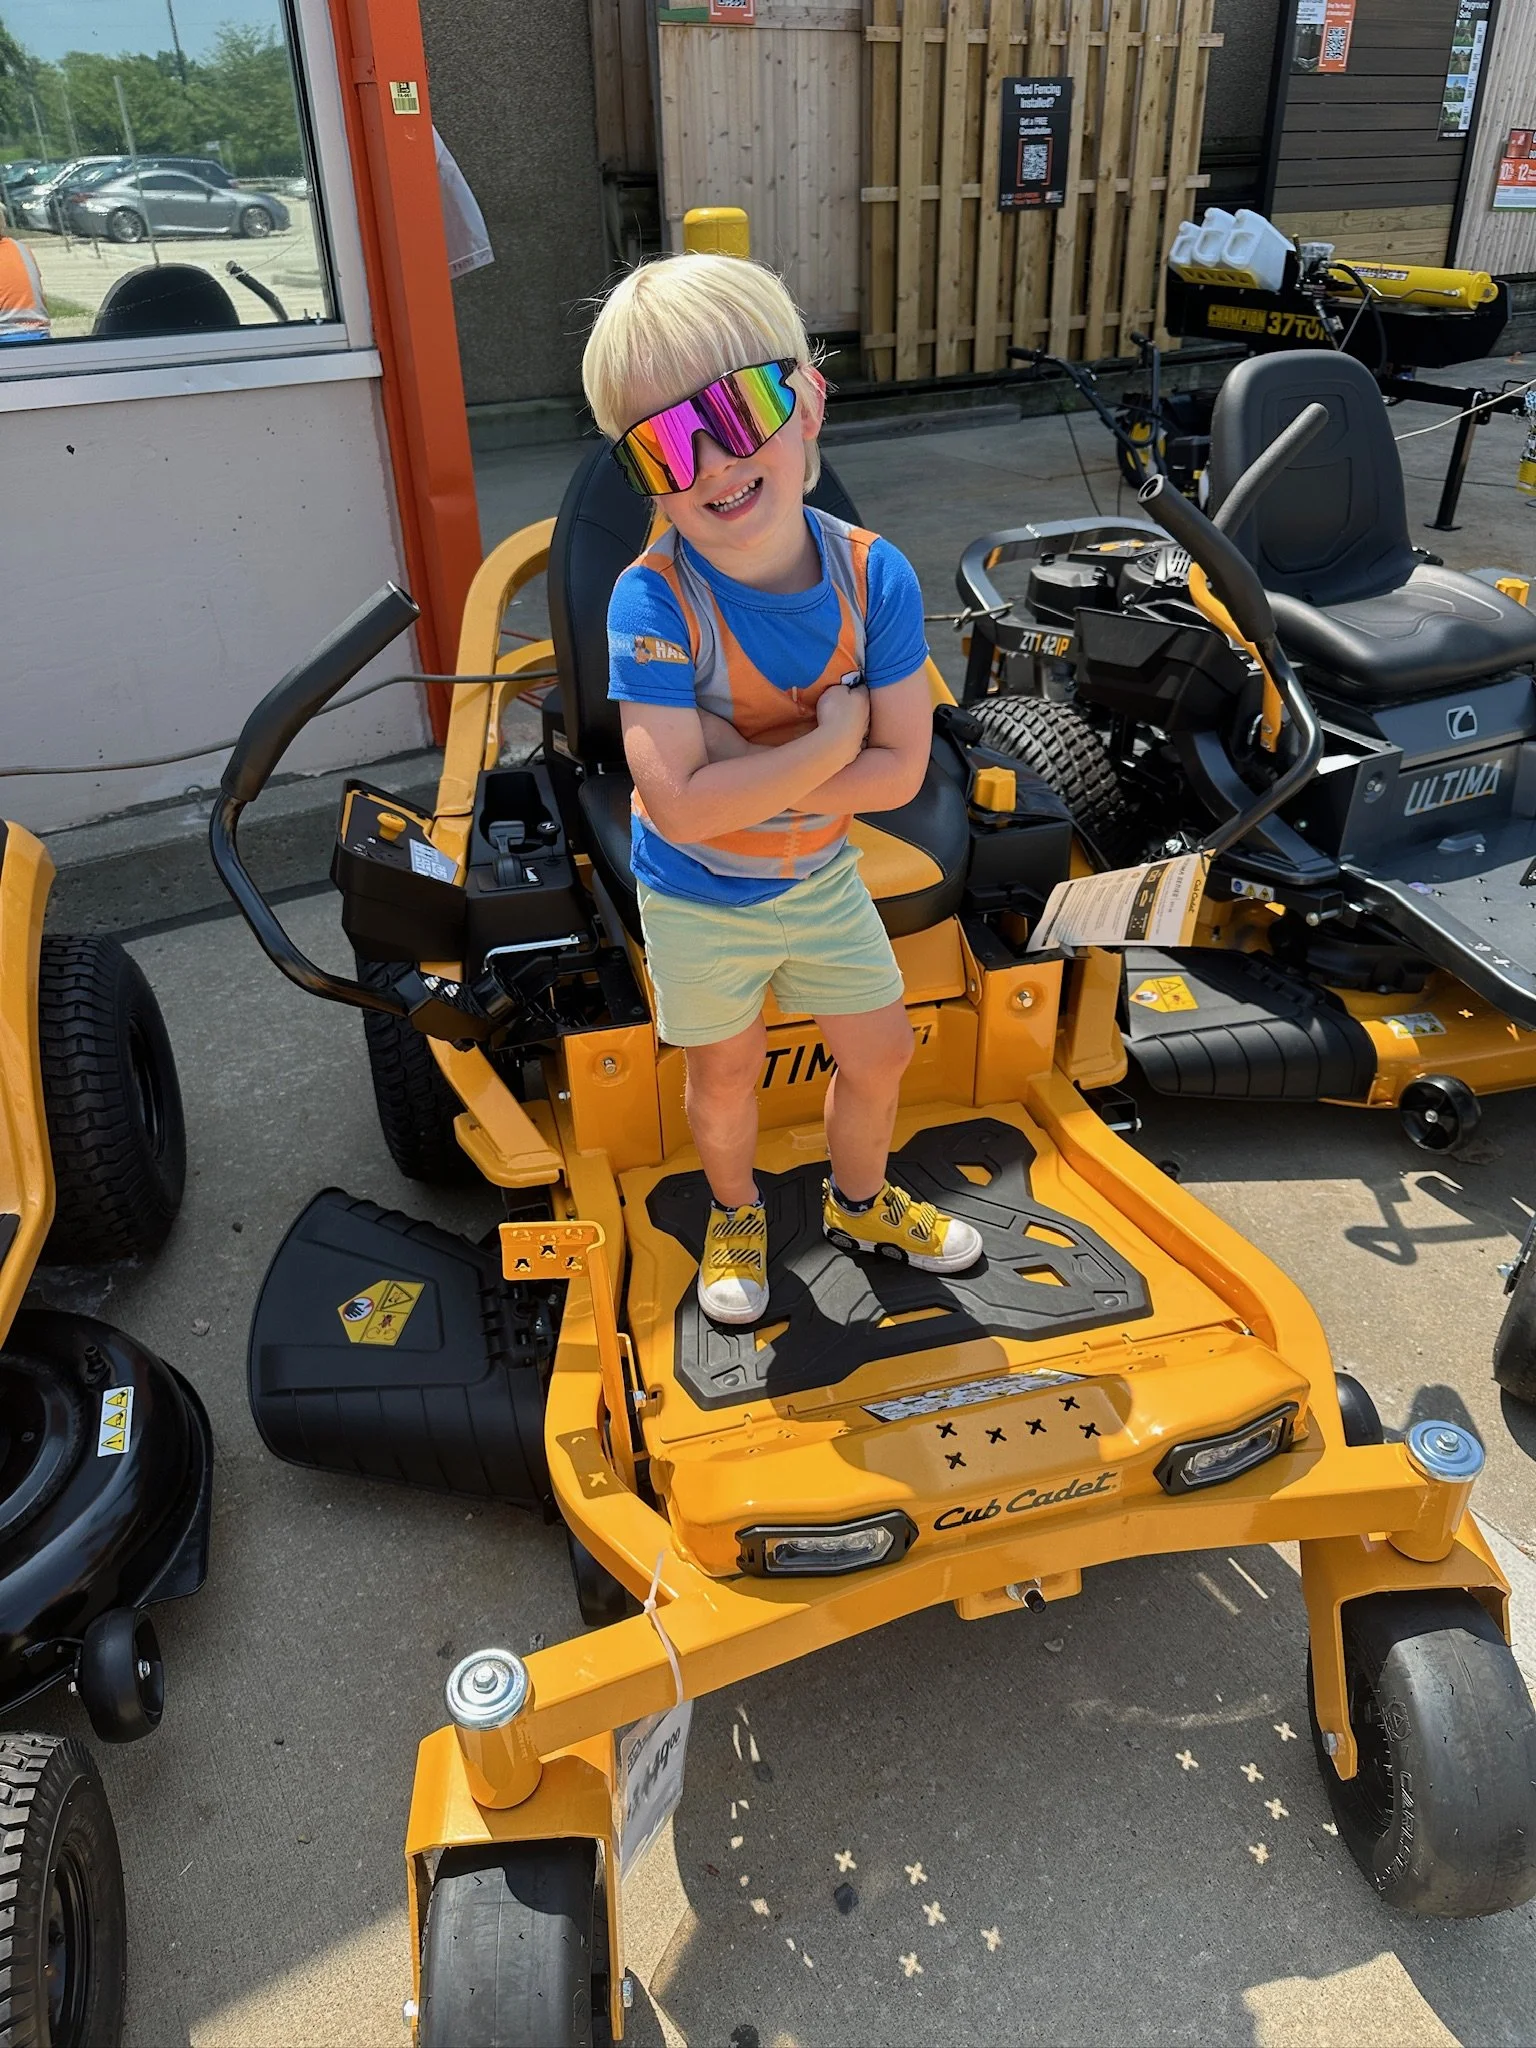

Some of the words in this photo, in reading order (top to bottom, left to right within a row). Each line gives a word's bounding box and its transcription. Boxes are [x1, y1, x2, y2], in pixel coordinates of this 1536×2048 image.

[1014, 84, 1033, 95] Need
[1033, 84, 1062, 96] Fencing
[1020, 97, 1055, 108] Installed?
[1207, 304, 1267, 329] CHAMPION
[1404, 760, 1502, 816] ULTIMA
[762, 1042, 838, 1089] TIM
[933, 1499, 1001, 1531] Cub
[1006, 1472, 1117, 1513] Cadet
